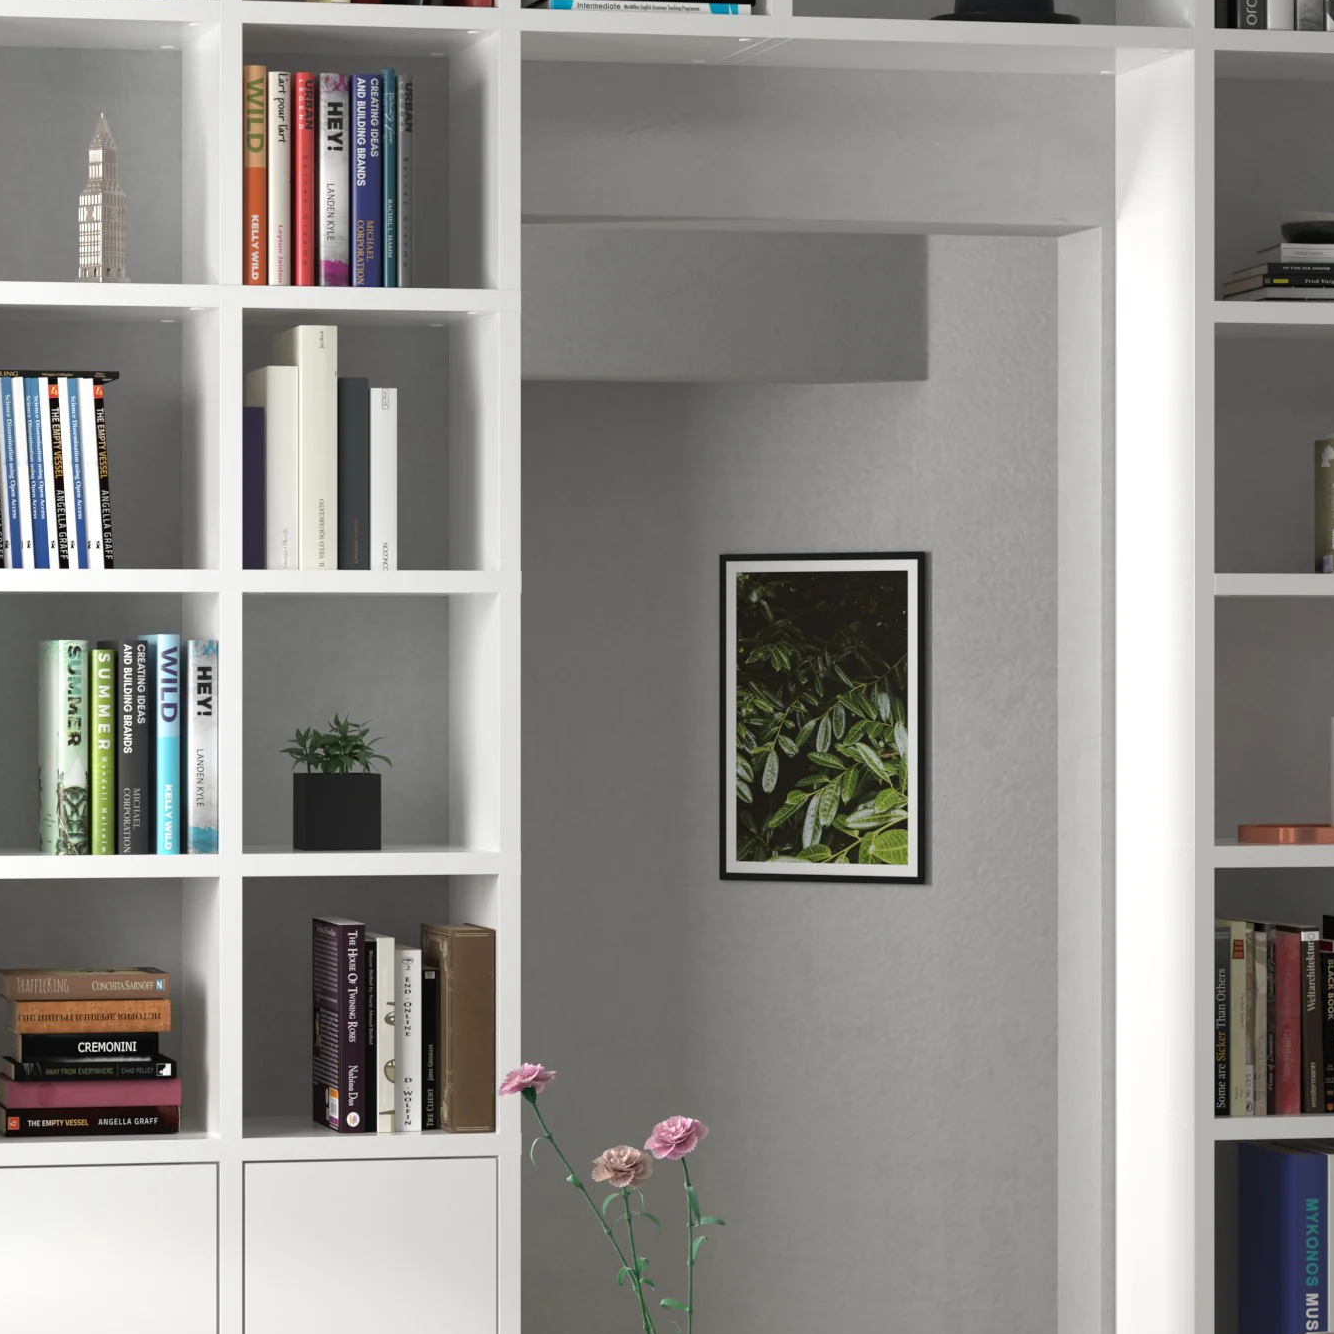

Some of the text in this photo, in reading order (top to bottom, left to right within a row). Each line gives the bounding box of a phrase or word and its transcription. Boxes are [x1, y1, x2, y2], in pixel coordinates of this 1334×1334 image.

[247, 77, 265, 153] WILD
[305, 79, 314, 130] URBAN
[327, 101, 343, 152] HEY!
[370, 77, 379, 157] CREATING IDEAS
[251, 213, 259, 280] KELLY WILD
[356, 219, 365, 285] CORPORATION
[68, 644, 82, 747] SUMMER
[161, 645, 178, 723] WILD
[197, 666, 213, 716] HEY!
[16, 977, 70, 994] TRAFFICKING
[91, 980, 155, 991] CONCHITA SARNOFF
[347, 930, 358, 1043] THE HOUSE OF TWINING ROSES
[77, 1041, 137, 1053] CREMONINI
[348, 1065, 358, 1106] Nabina Das
